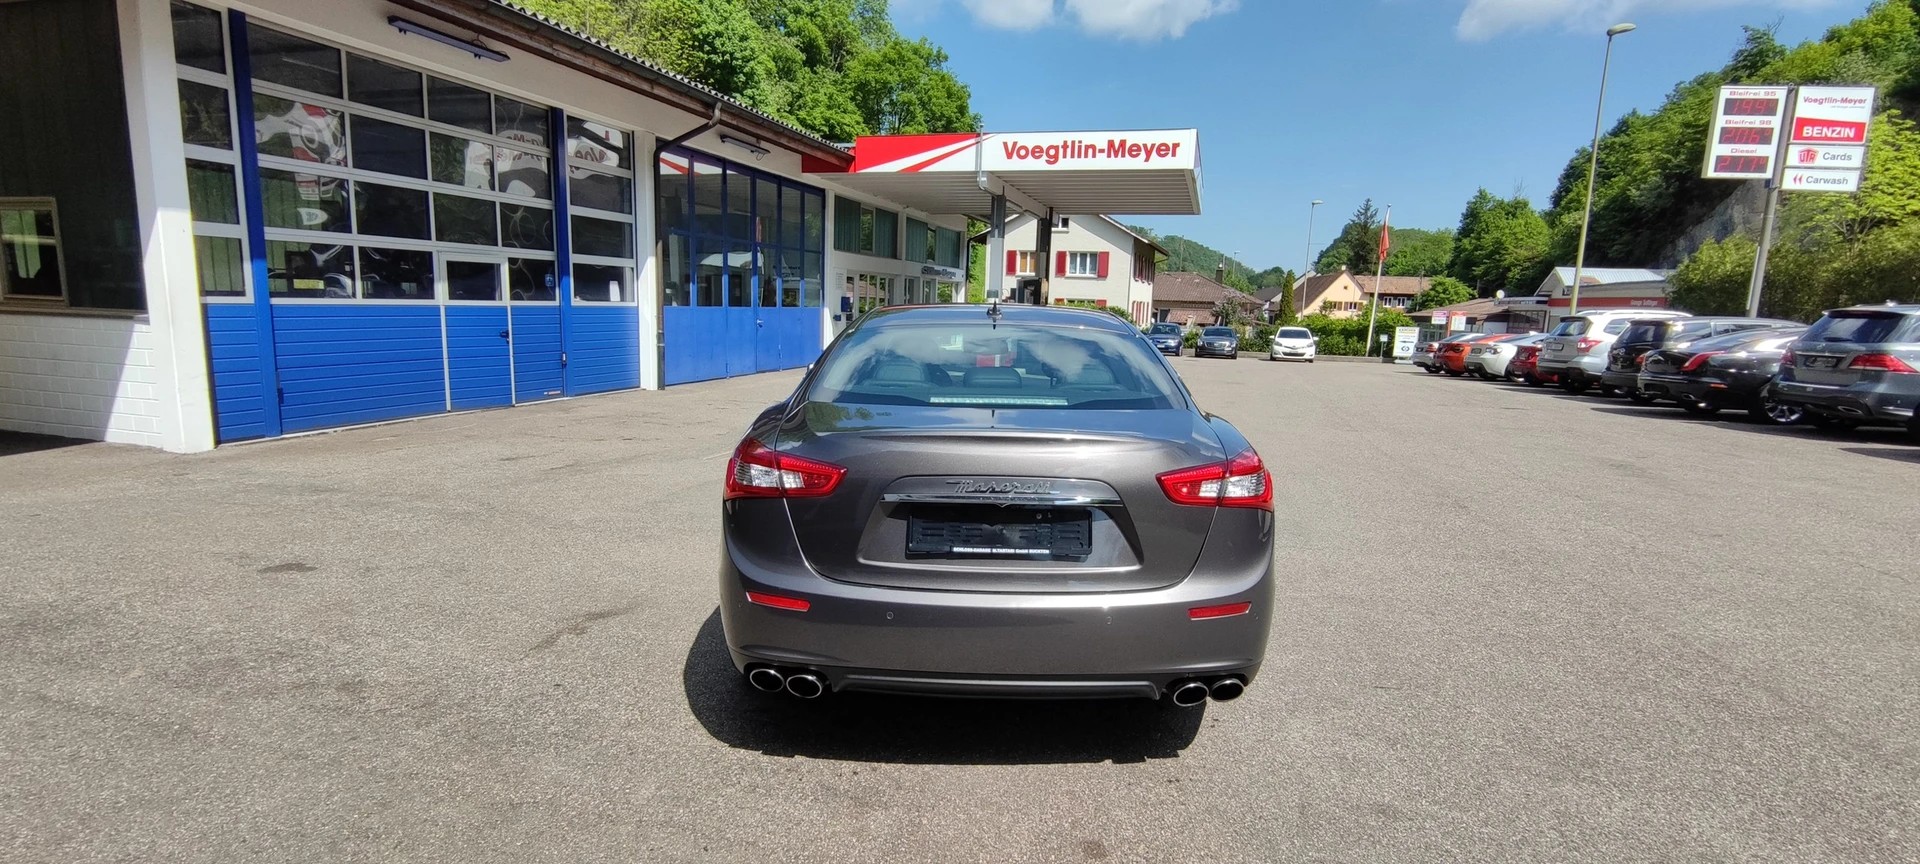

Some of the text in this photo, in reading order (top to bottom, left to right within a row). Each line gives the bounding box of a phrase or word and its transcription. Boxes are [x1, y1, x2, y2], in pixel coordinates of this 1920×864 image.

[1803, 96, 1867, 105] Voegtlin-Meyer
[1802, 125, 1856, 139] BENZIN
[1002, 139, 1180, 165] Voegtlin-Meyer
[1822, 151, 1853, 161] Cards
[1805, 175, 1849, 185] Carwash
[945, 479, 1060, 495] Maserati
